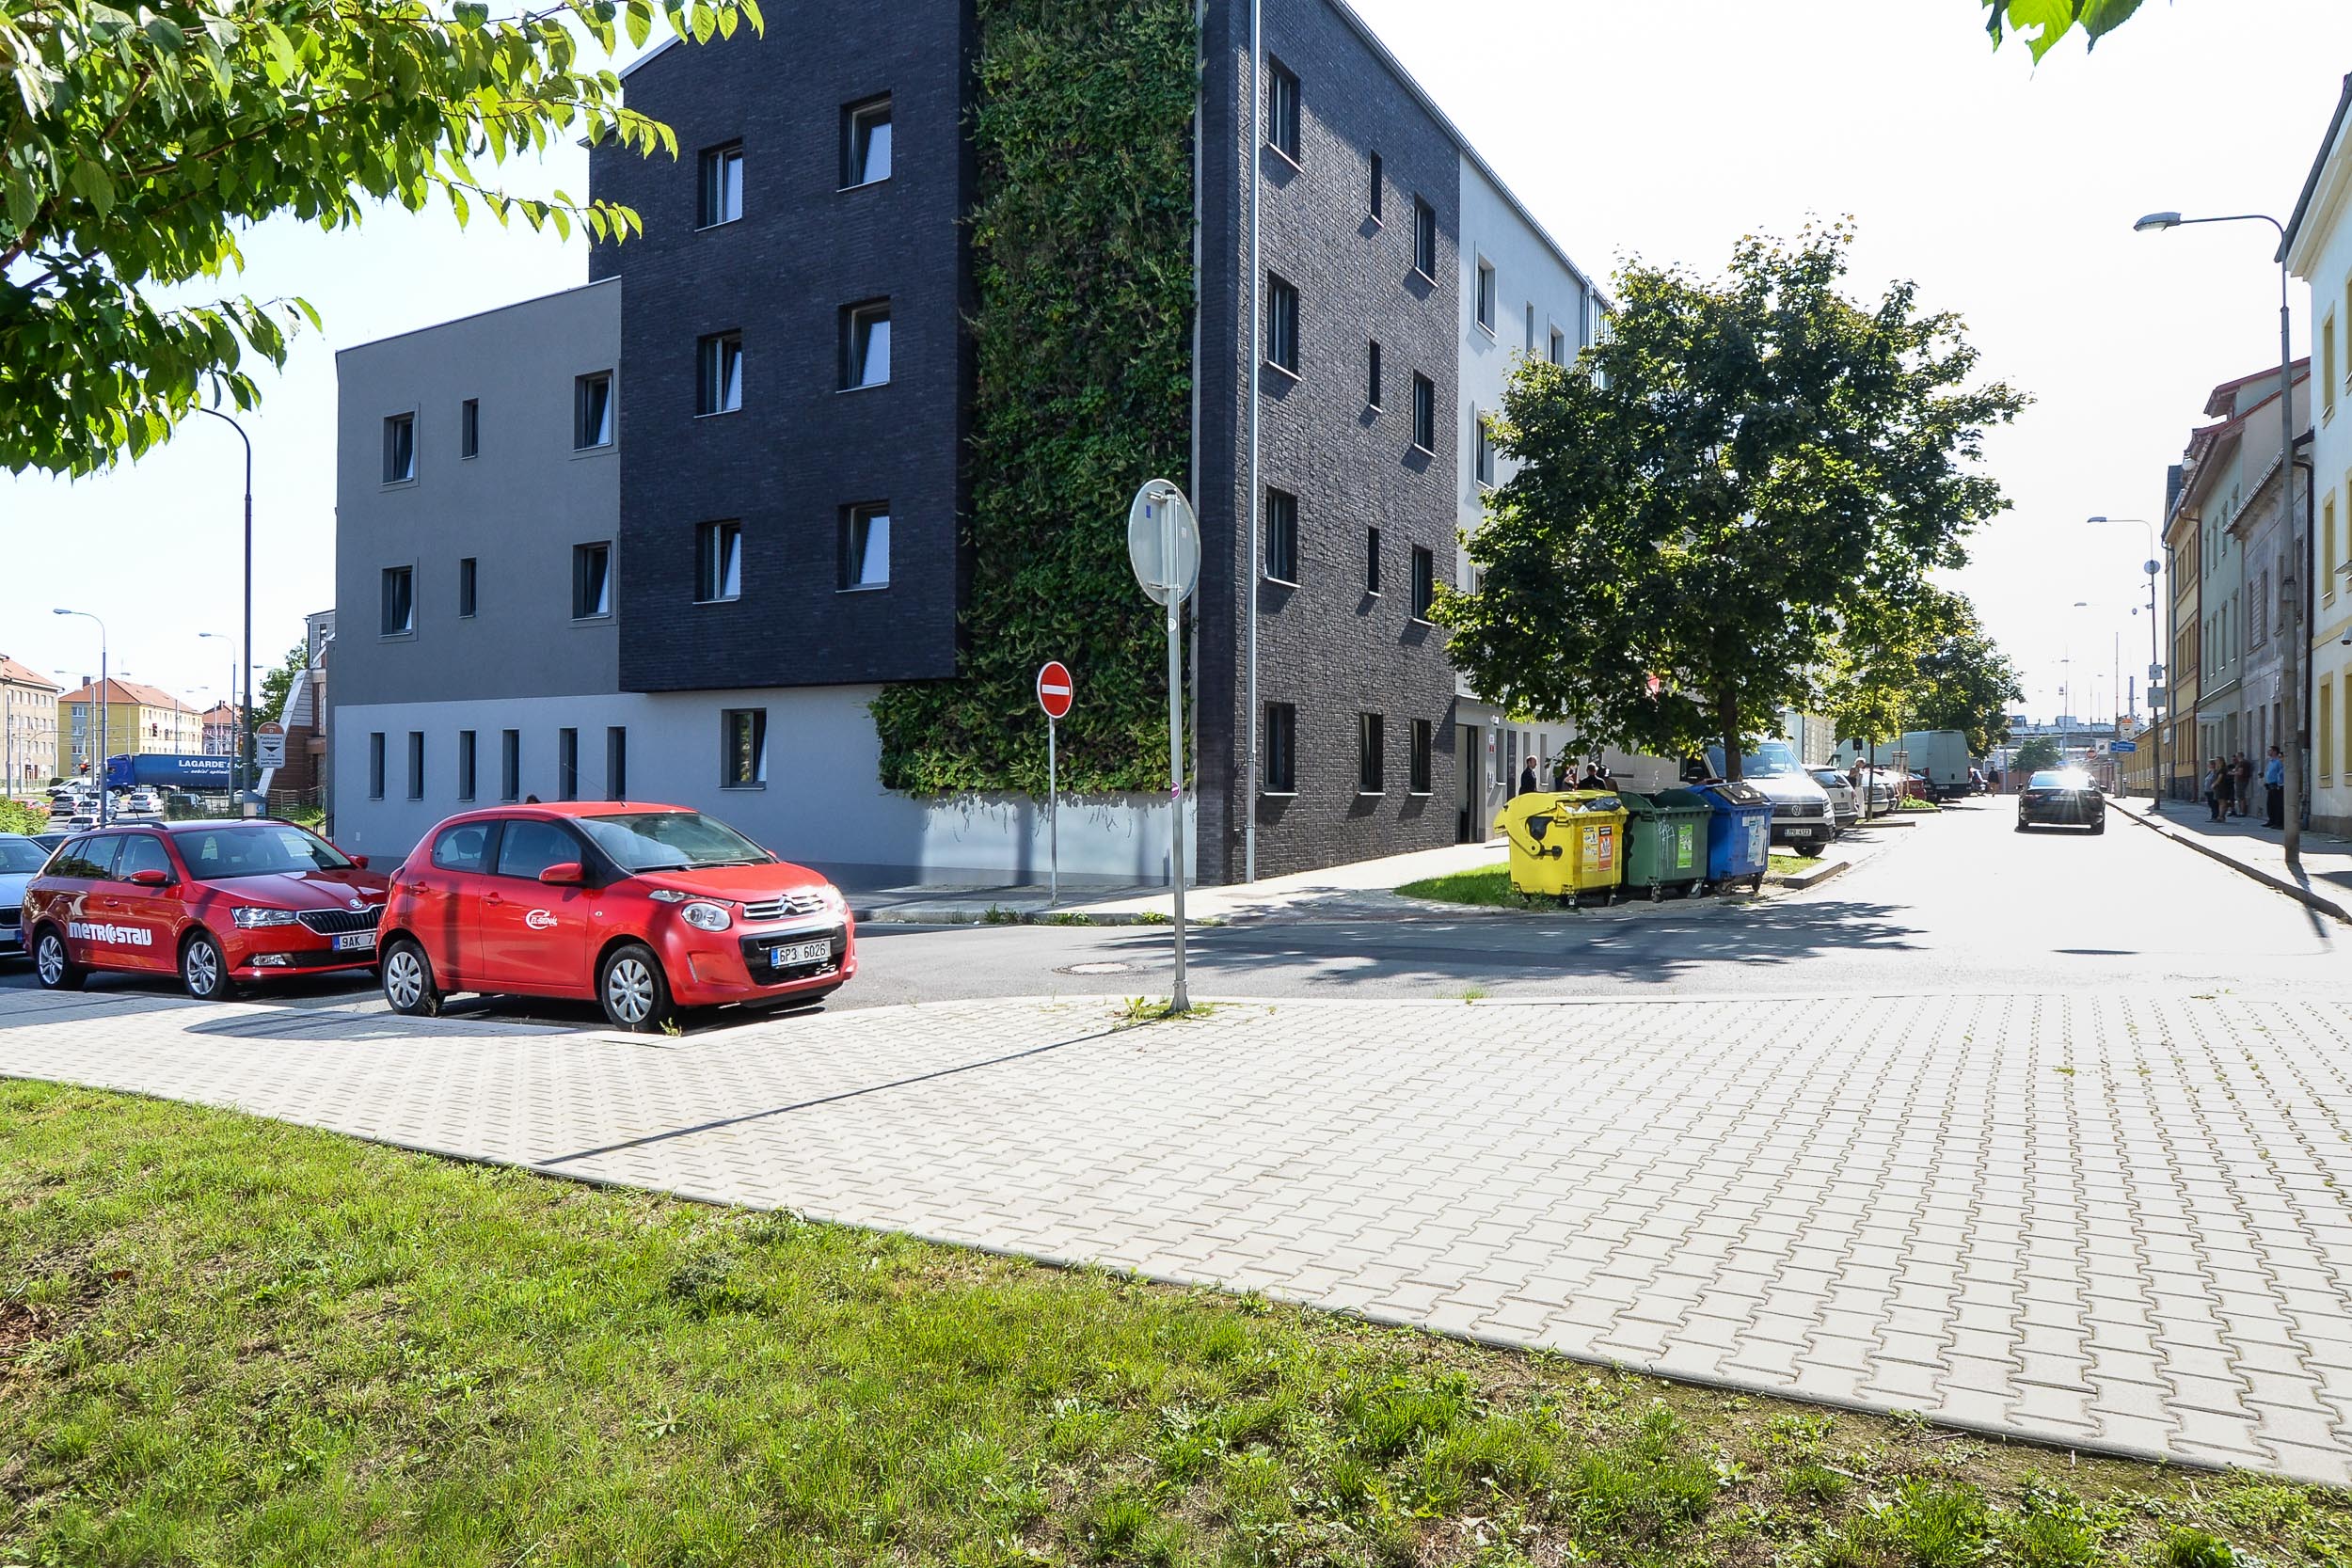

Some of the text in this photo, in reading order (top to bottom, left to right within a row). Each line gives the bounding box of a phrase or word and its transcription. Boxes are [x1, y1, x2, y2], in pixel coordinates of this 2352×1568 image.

[178, 759, 226, 768] LAGARDE
[342, 935, 360, 947] 9AK
[780, 947, 798, 962] 6P3
[803, 942, 826, 958] 6026
